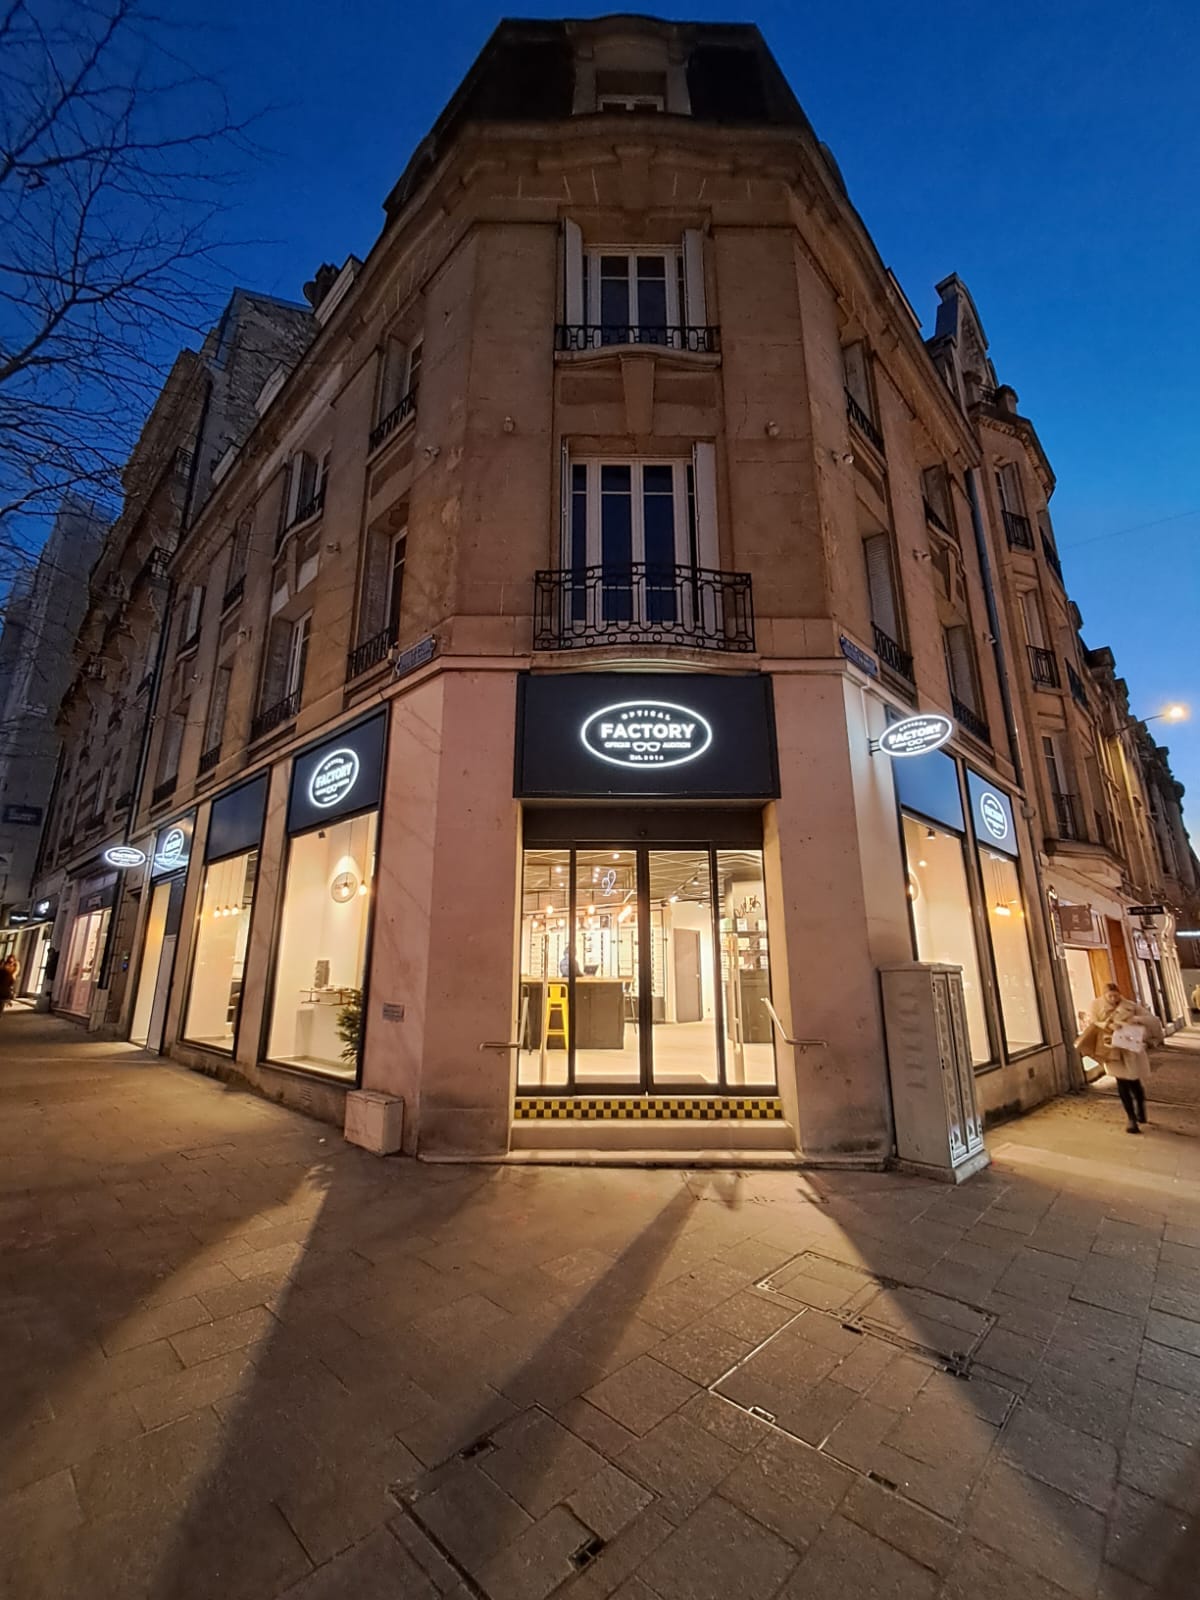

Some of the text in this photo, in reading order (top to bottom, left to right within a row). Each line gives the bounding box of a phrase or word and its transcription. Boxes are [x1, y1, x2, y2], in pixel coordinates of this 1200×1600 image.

[621, 710, 671, 720] OPTICAL
[600, 723, 696, 739] FACTORY
[888, 722, 942, 745] FACTORY
[315, 761, 353, 789] FACTORY
